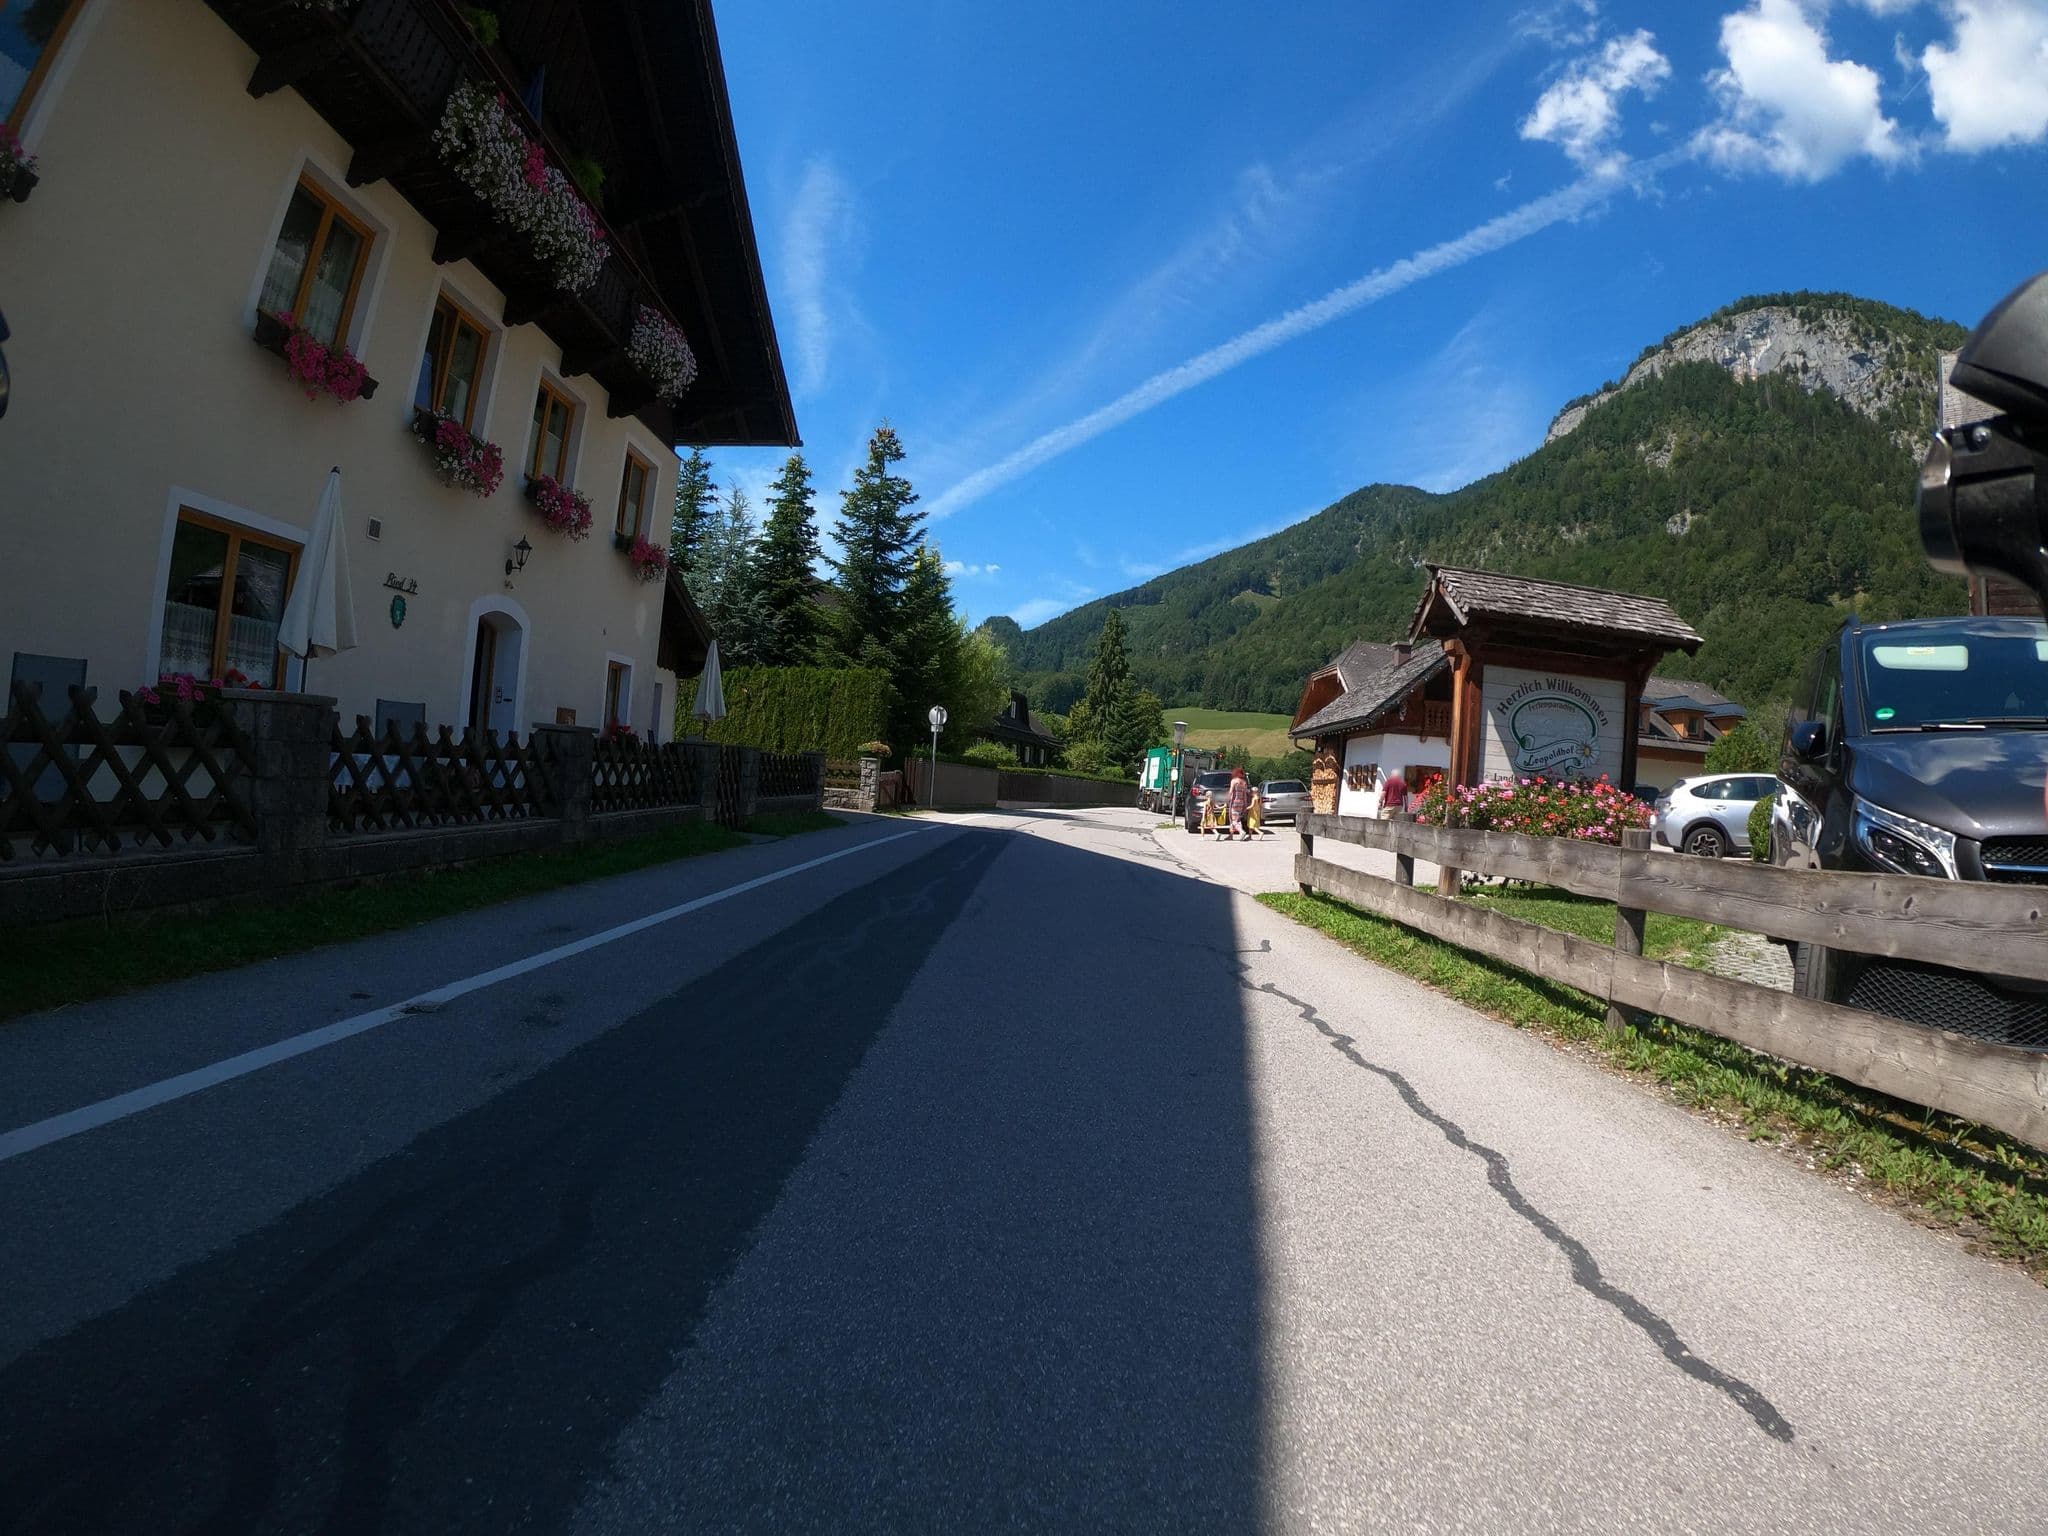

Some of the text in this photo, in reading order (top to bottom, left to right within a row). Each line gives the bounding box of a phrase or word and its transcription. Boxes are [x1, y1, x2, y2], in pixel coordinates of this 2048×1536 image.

[1496, 678, 1609, 727] Herzlich Willkommen
[1523, 745, 1575, 767] Leopoldhof
